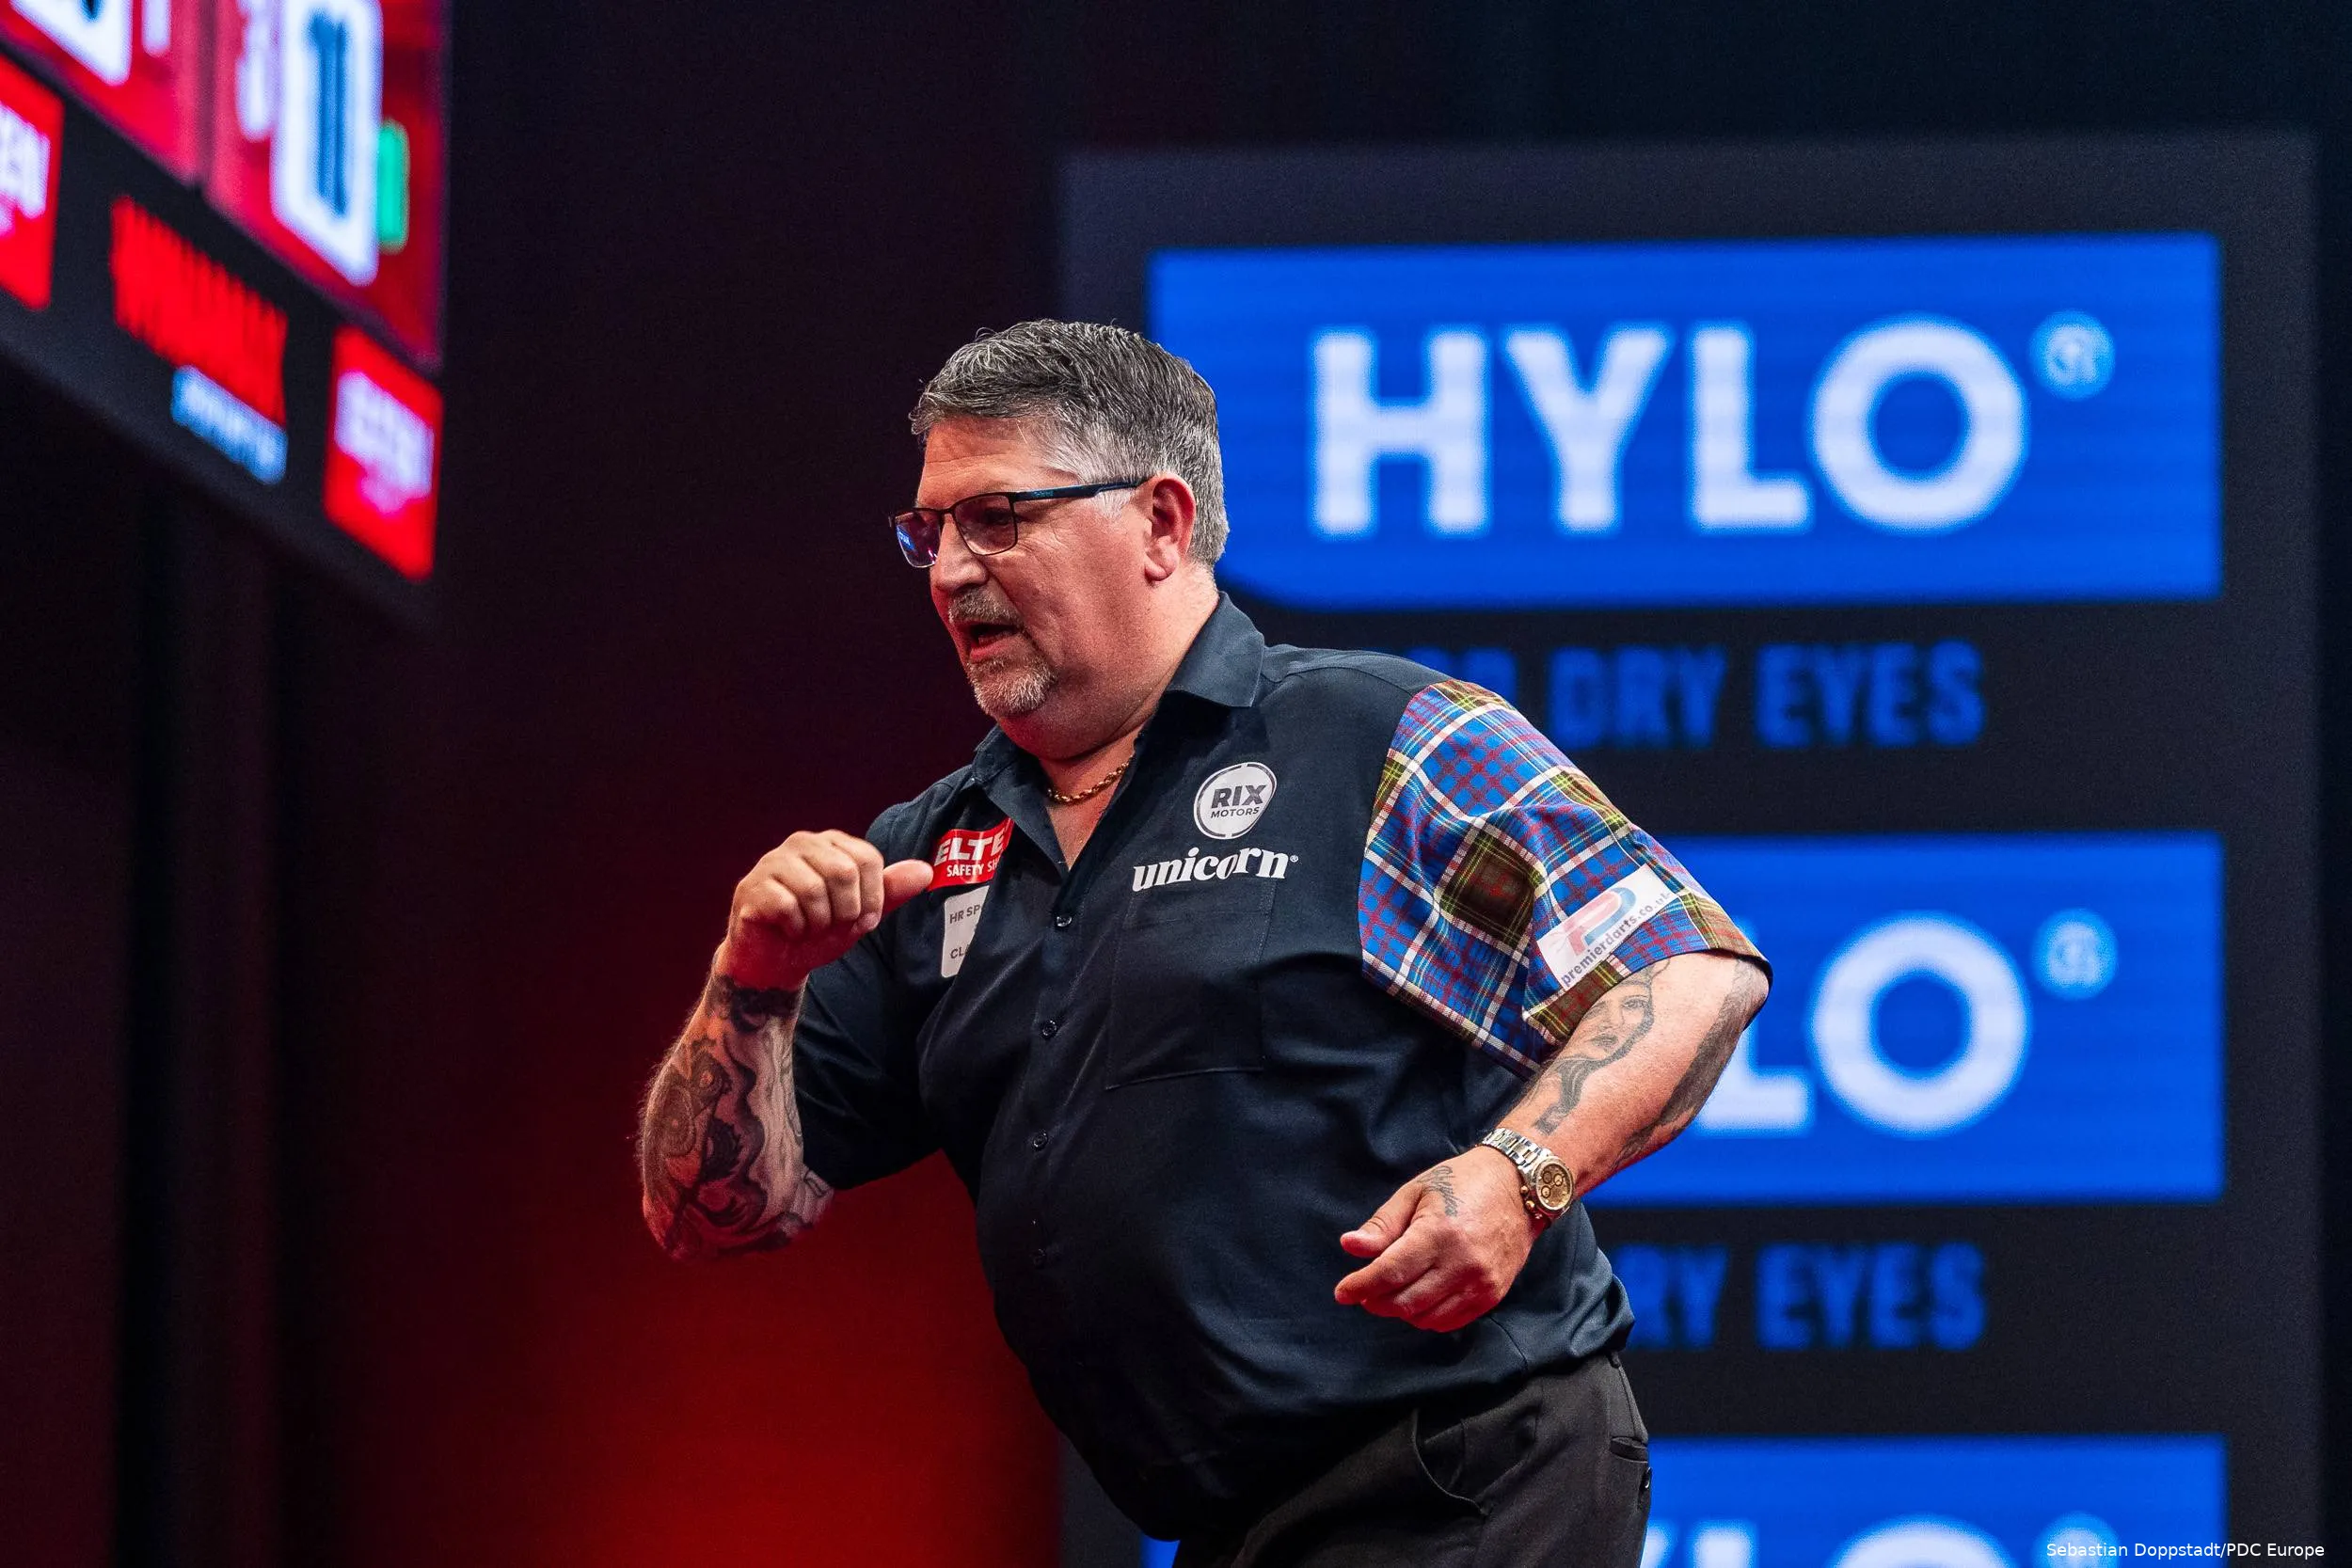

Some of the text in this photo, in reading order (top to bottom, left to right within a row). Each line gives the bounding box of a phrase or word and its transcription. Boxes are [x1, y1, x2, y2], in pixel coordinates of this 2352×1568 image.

[1311, 318, 2030, 538] HYLO
[1550, 645, 1727, 750] DRY
[1756, 641, 1985, 746] EYES
[1210, 806, 1261, 818] MOTORS
[1211, 784, 1266, 809] RIX
[934, 819, 1010, 866] ELTE
[946, 863, 985, 878] SAFETY
[1132, 847, 1290, 892] unicorn
[949, 910, 964, 924] HR
[1754, 1241, 1987, 1351] EYES
